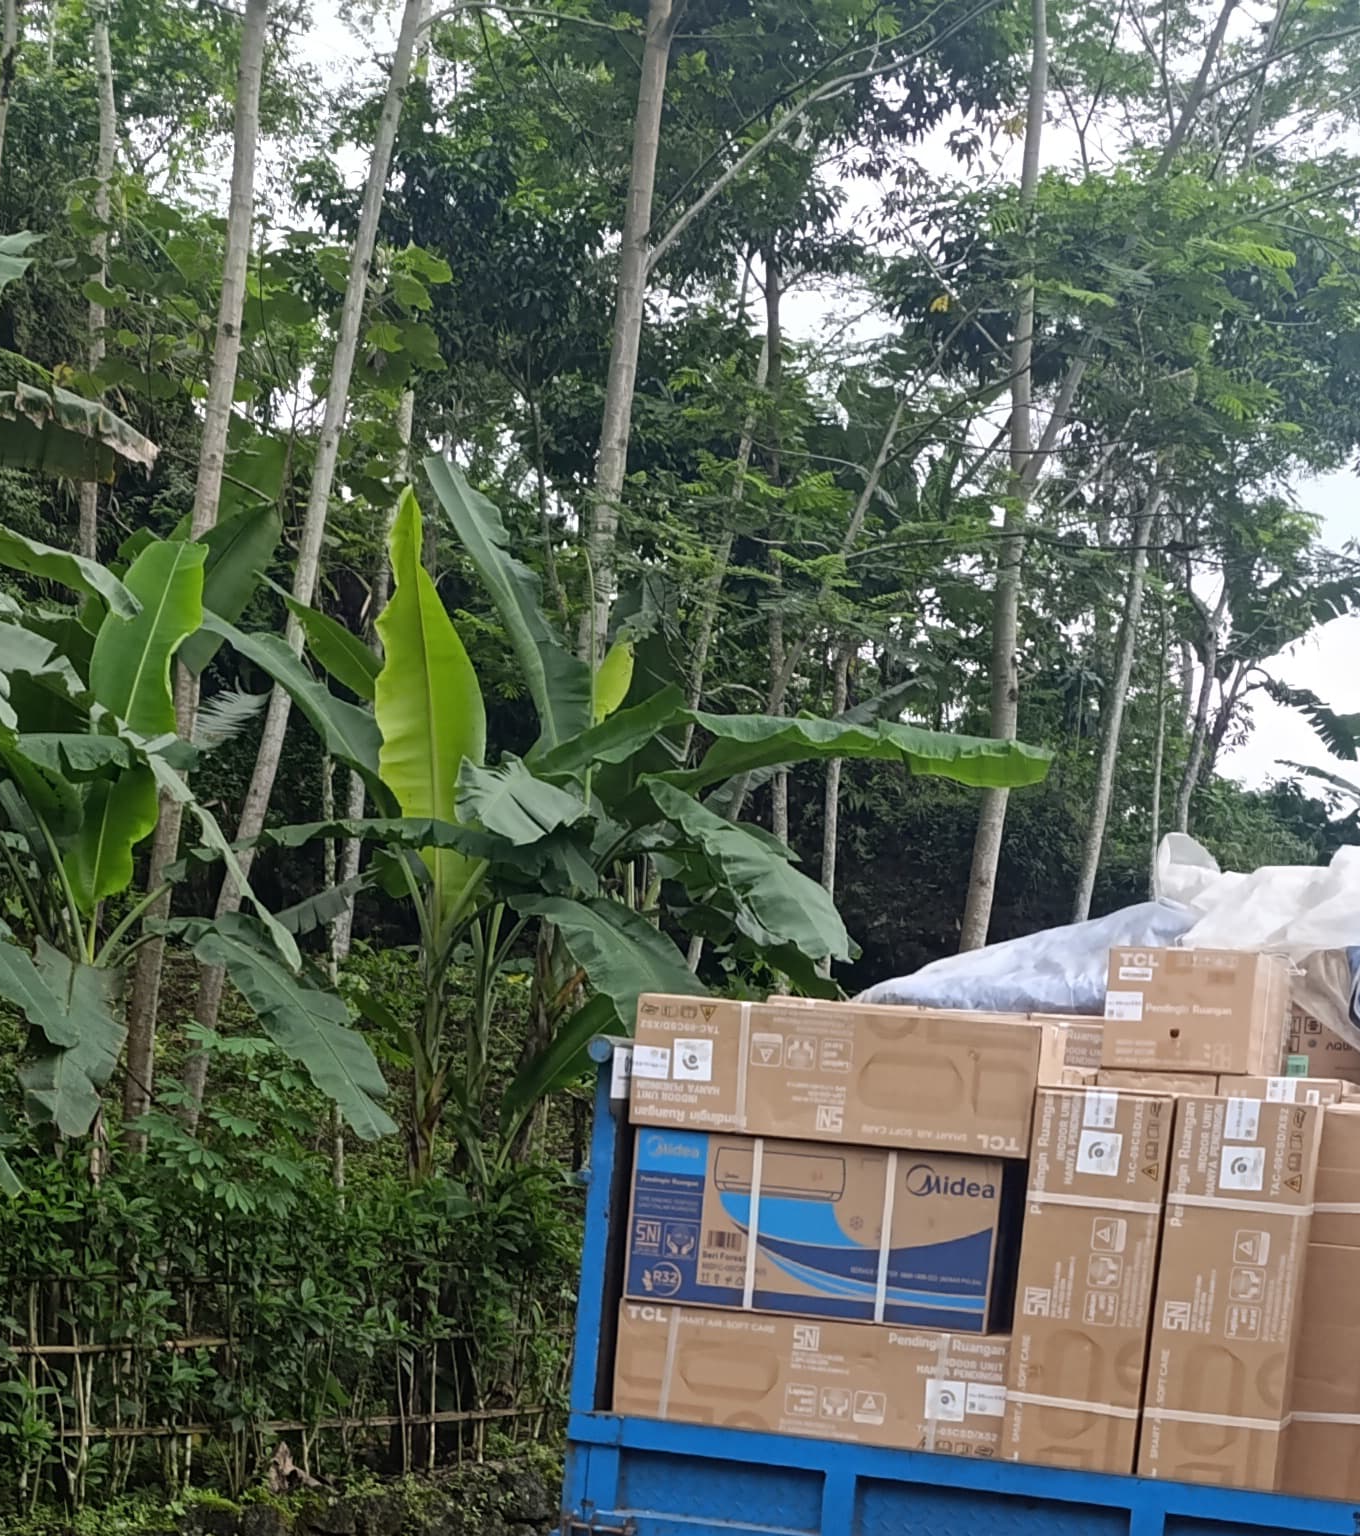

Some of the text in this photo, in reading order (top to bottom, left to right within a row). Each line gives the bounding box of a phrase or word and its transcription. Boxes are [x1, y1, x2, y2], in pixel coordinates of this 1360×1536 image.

[1120, 953, 1159, 968] TCL
[634, 1104, 686, 1122] Ruangan
[1177, 1101, 1197, 1159] Ruangan
[646, 1135, 700, 1159] Midea
[978, 1133, 1020, 1151] TCL
[906, 1164, 995, 1199] Midea
[636, 1220, 661, 1247] SNI
[653, 1269, 678, 1284] R32
[627, 1305, 668, 1323] TCL
[952, 1338, 1006, 1357] Ruangan
